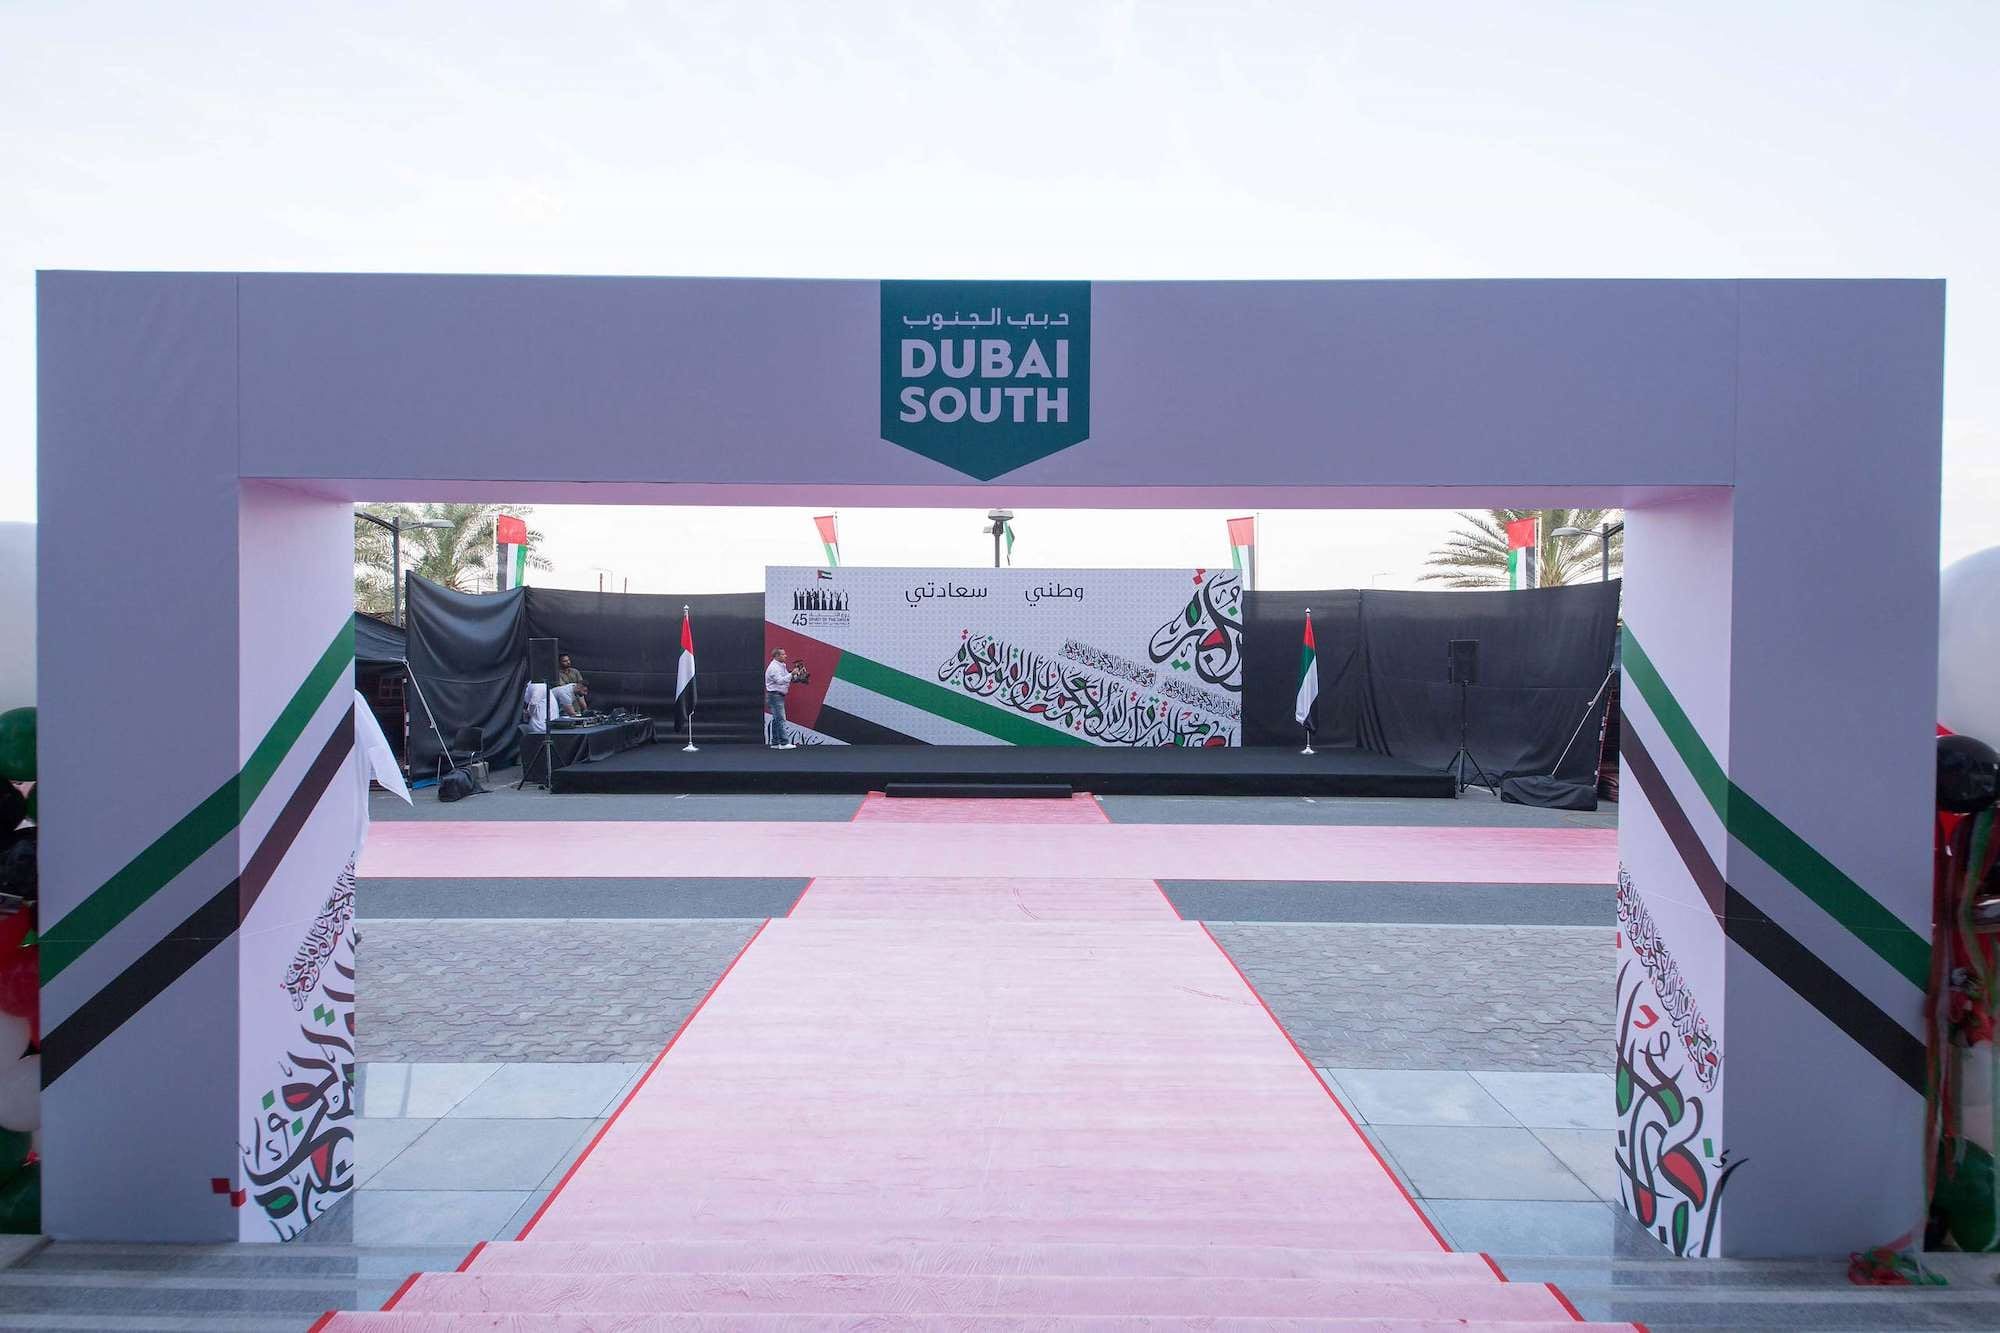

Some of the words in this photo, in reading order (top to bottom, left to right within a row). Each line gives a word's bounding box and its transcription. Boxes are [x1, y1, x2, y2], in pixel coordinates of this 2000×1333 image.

[903, 307, 1001, 330] الجنوب
[1007, 312, 1069, 329] دبي
[901, 338, 1069, 378] DUBAI
[900, 386, 1069, 423] SOUTH
[905, 582, 987, 608] سعادتي
[1025, 582, 1084, 607] وطني
[792, 613, 808, 626] 45
